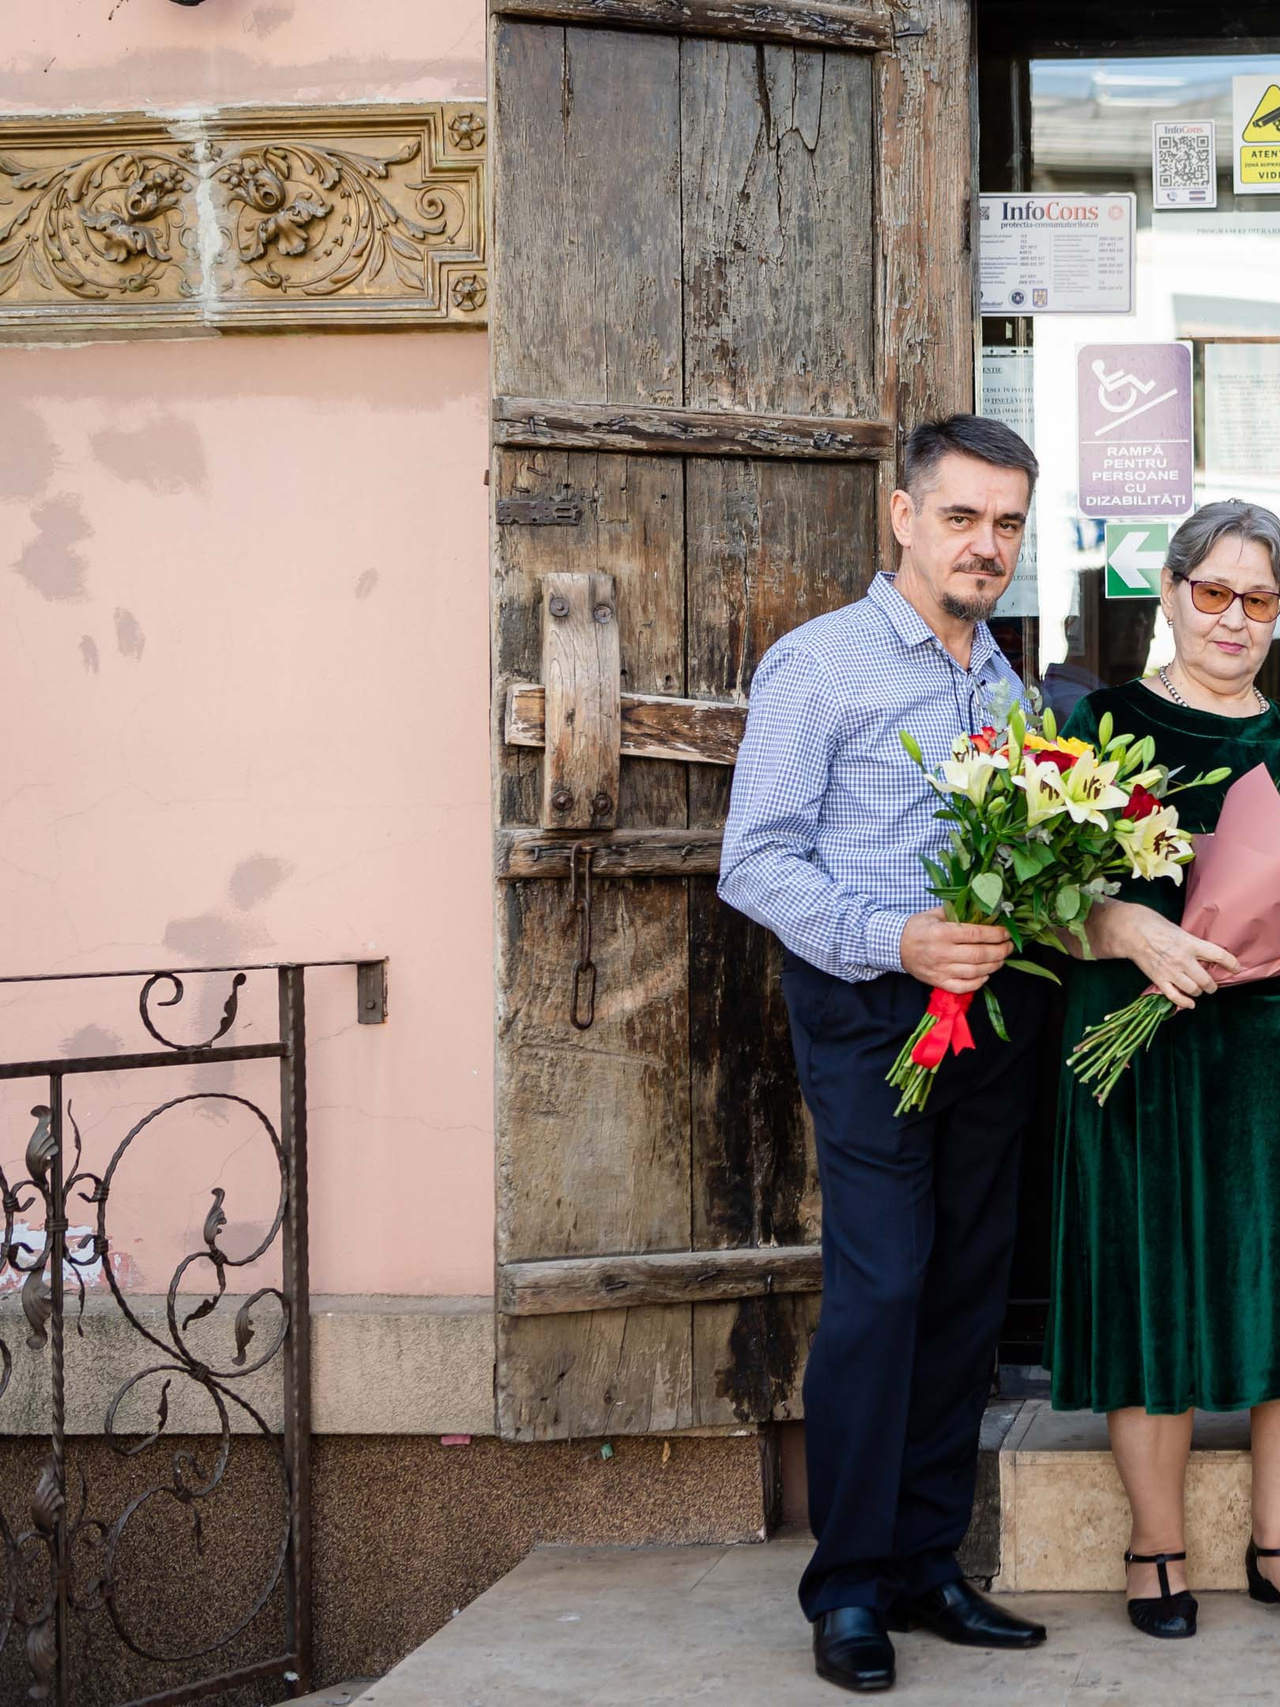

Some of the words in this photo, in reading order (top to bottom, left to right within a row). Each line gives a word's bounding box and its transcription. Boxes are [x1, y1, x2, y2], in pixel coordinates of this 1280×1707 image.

[1164, 126, 1203, 135] InfoCons
[1002, 201, 1099, 220] InfoCons
[1107, 444, 1164, 456] RAMPĂ
[1103, 458, 1167, 469] PENTRU
[1092, 470, 1179, 481] PERSOANE
[1124, 483, 1147, 493] CU
[1086, 493, 1186, 508] DIZABILITĂȚI
